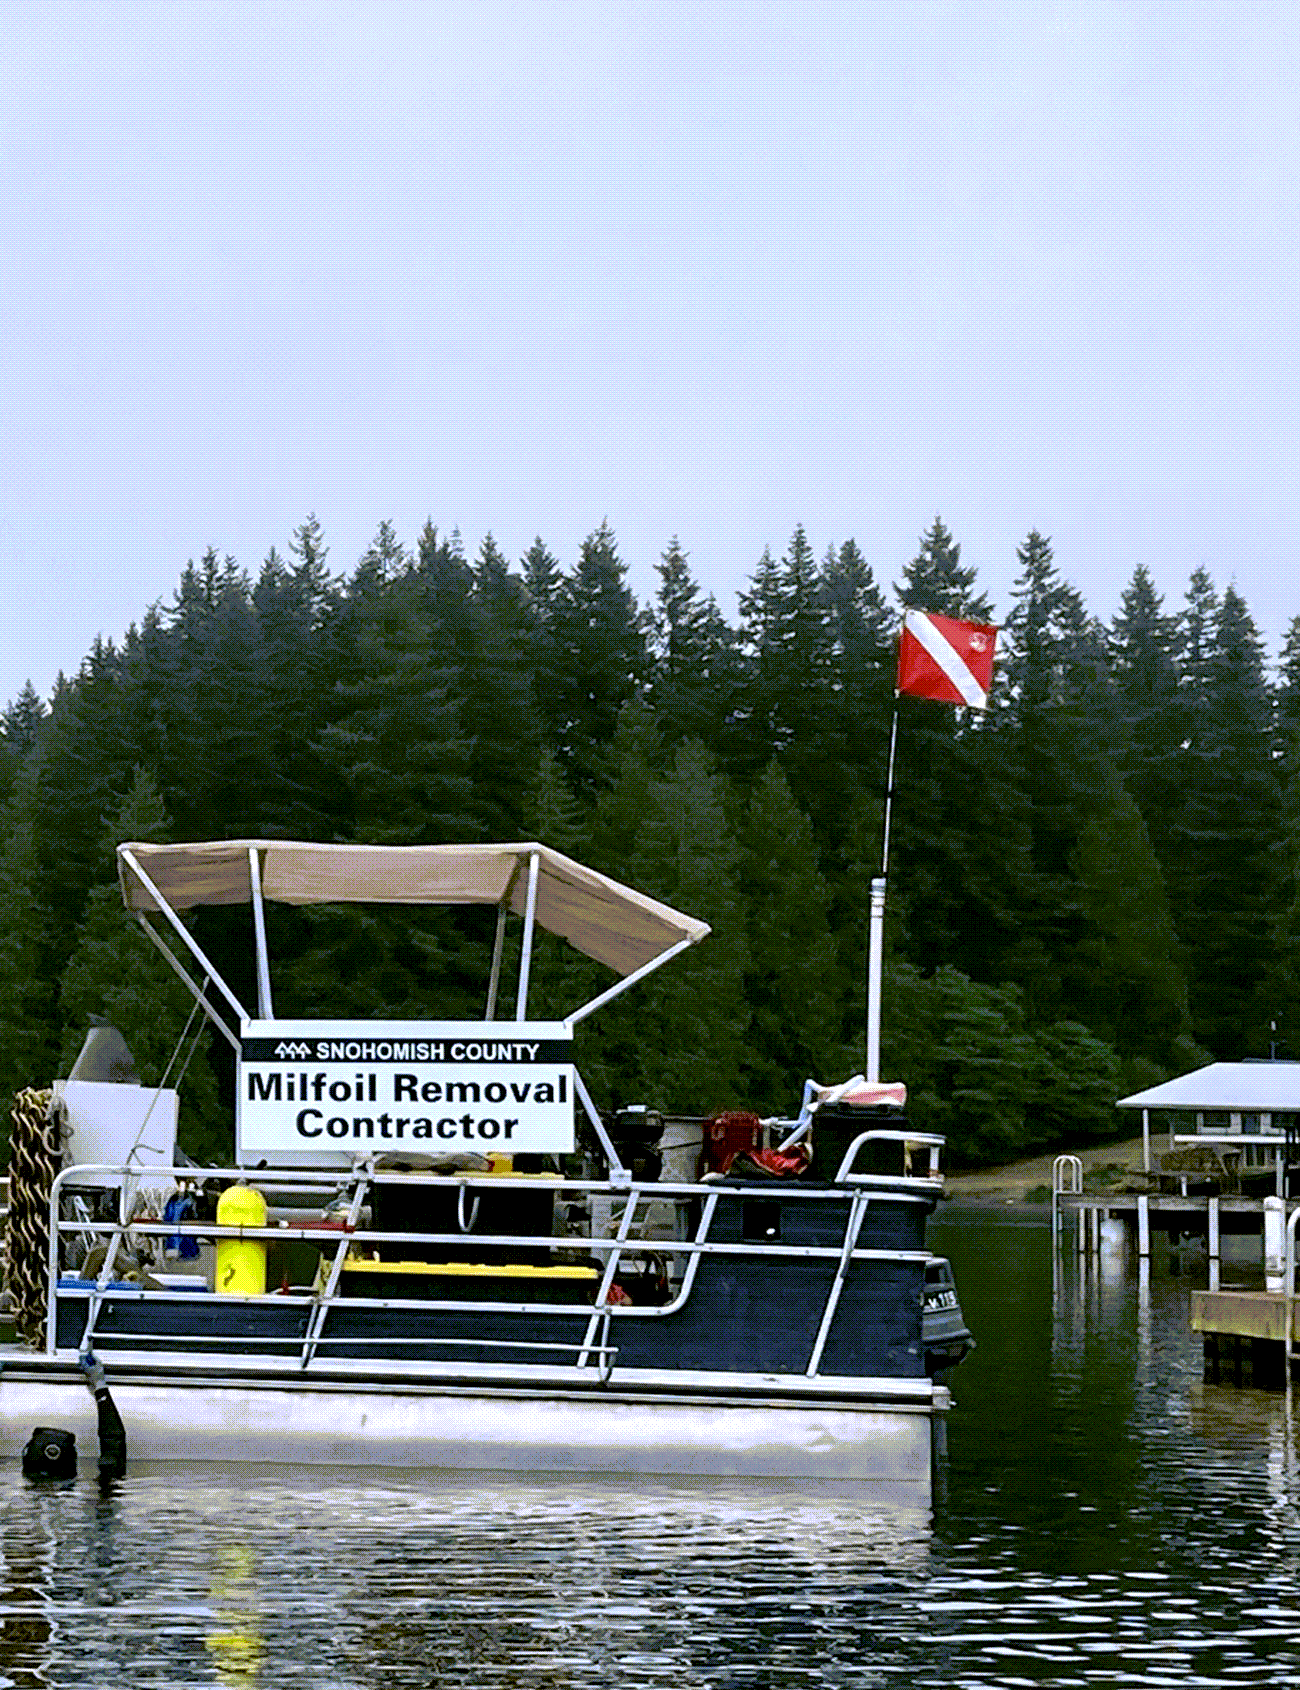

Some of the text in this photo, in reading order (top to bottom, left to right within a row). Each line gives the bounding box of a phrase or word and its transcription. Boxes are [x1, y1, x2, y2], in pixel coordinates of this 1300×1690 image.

[316, 1042, 539, 1060] SNOHOMISH COUNTY
[247, 1072, 567, 1104] Milfoil Removal
[295, 1108, 519, 1140] Contractor
